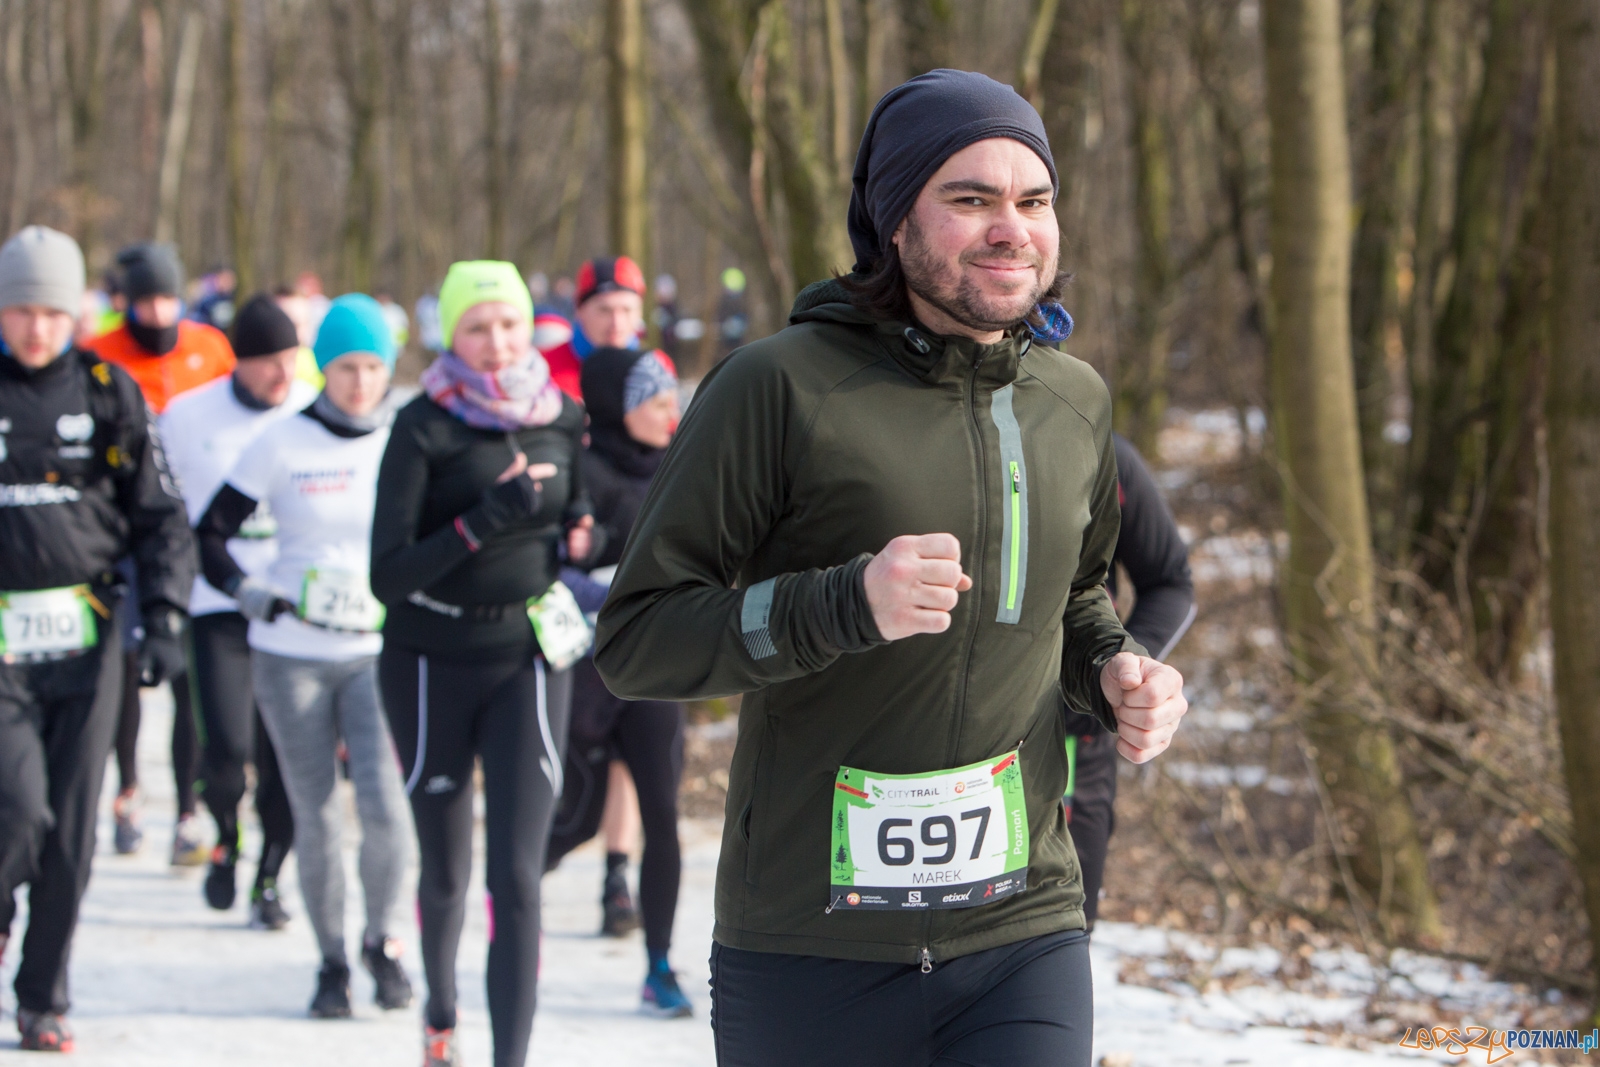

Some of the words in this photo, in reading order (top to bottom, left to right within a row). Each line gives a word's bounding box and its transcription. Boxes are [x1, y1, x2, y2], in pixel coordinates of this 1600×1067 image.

[878, 805, 992, 866] 697
[1011, 809, 1024, 855] Poznań
[912, 869, 962, 884] MAREK
